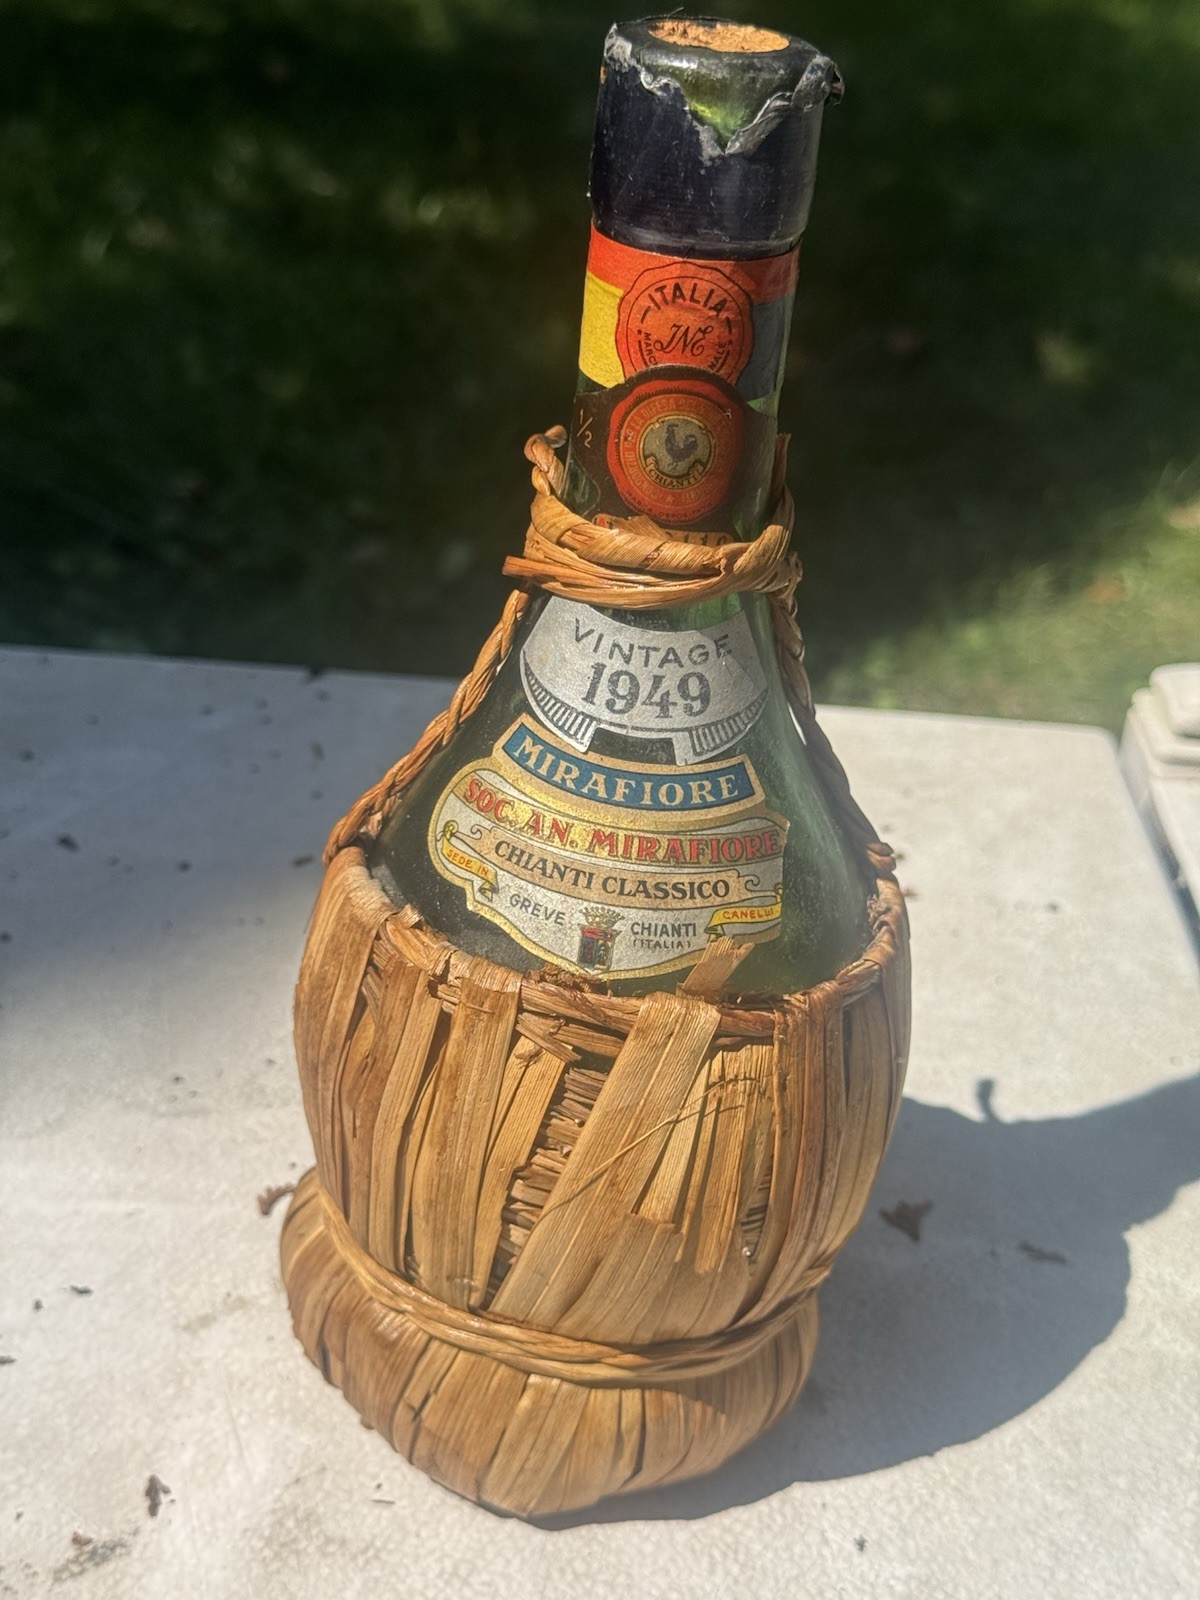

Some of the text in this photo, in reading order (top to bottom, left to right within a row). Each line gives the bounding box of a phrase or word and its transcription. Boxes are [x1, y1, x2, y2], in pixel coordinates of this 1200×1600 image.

[648, 282, 730, 318] ITALIA
[643, 332, 659, 366] MARC
[576, 408, 594, 449] 1/2
[648, 468, 699, 488] CHIANTI
[574, 617, 732, 669] VINTAGE
[582, 661, 712, 719] 1949
[513, 733, 740, 806] MIRAFIORE
[521, 809, 579, 849] AN.
[584, 827, 784, 866] MIRAFIORE
[446, 849, 489, 877] SEDE IN
[494, 840, 731, 900] CHIANTI CLASSICO
[509, 893, 566, 926] GREVE
[630, 922, 697, 938] CHIANTI
[633, 939, 692, 950] (ITALIA)
